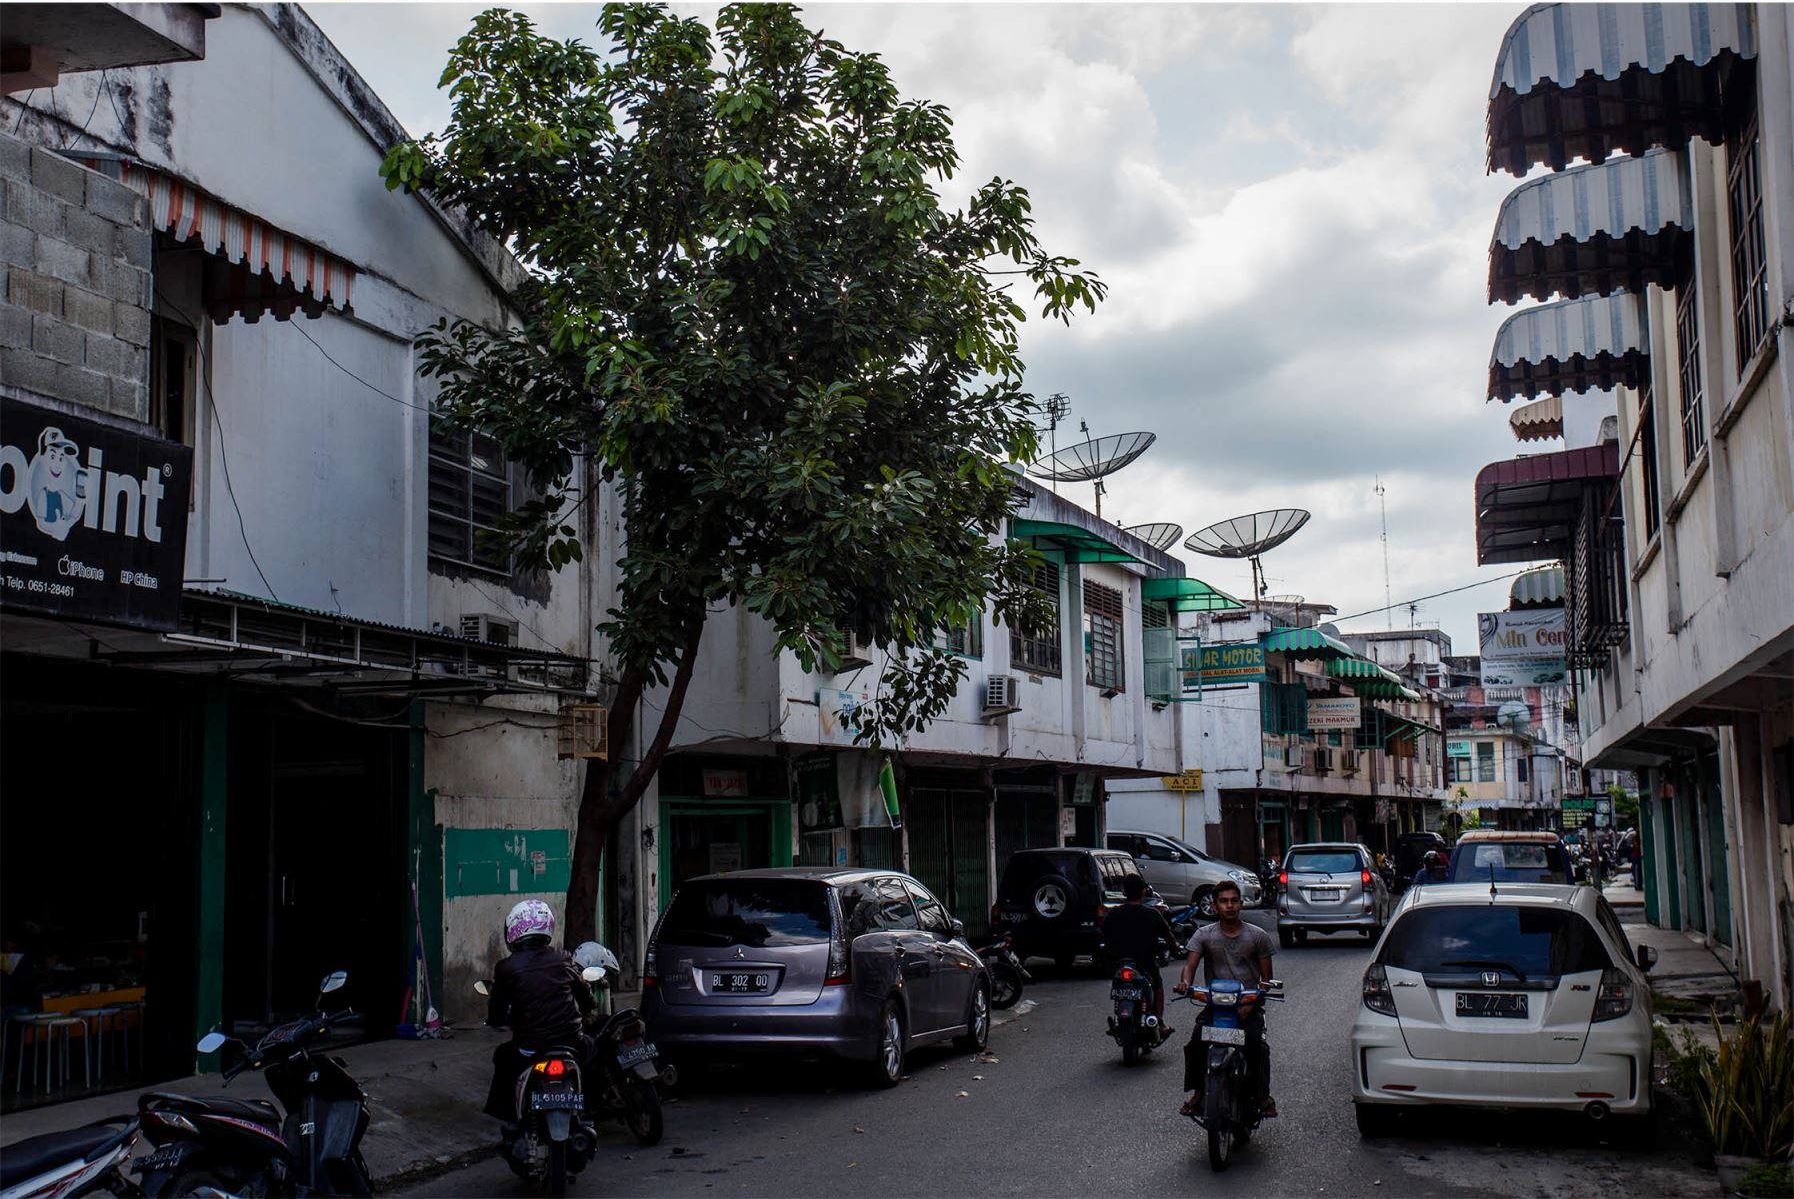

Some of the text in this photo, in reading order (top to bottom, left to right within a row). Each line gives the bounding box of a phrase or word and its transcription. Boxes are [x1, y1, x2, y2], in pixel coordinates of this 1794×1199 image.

[69, 560, 105, 581] iPhone
[120, 569, 134, 584] HP
[134, 571, 158, 589] China
[7, 575, 26, 590] Telp.
[27, 579, 75, 597] 0651-28461
[1222, 647, 1262, 667] MOTOR
[712, 974, 724, 987] BL
[731, 974, 749, 987] 302
[1456, 994, 1527, 1011] BL 77 JR
